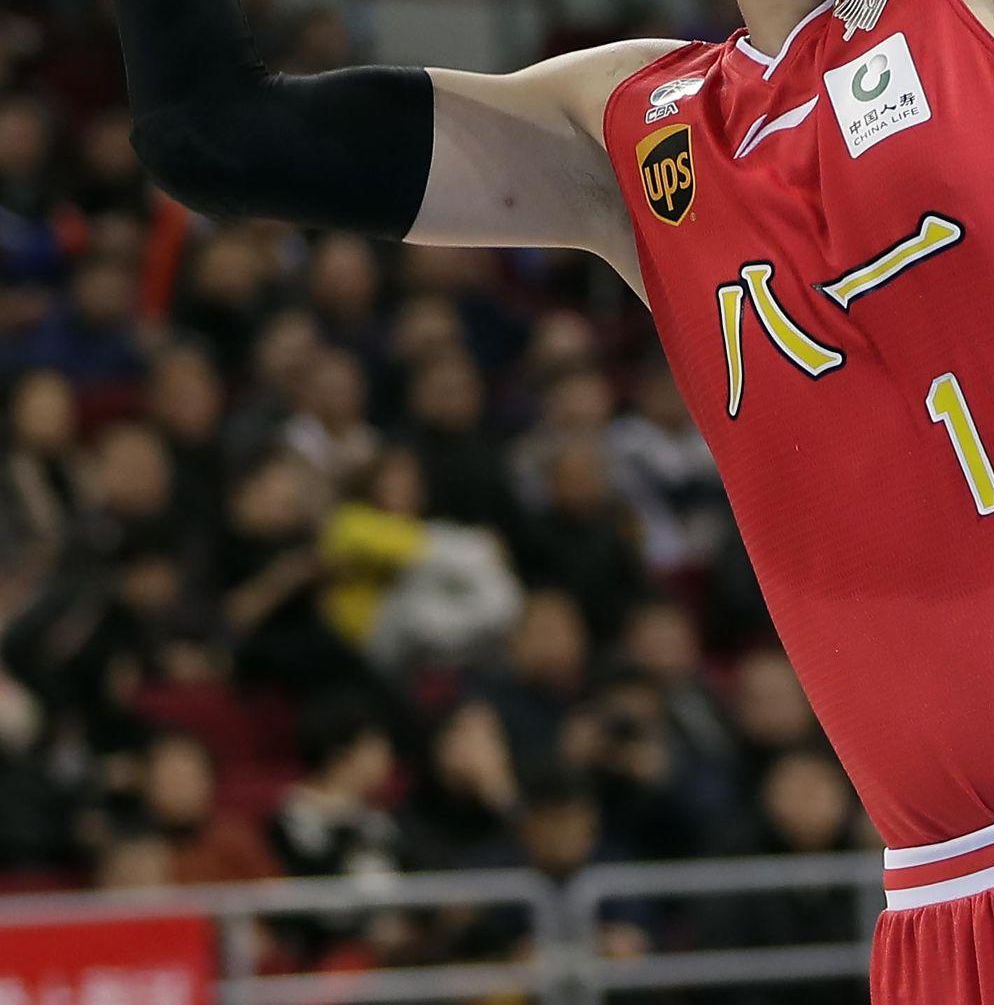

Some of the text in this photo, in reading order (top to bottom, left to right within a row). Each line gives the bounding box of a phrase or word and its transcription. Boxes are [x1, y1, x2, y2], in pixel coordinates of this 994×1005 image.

[646, 102, 678, 123] CBA
[849, 92, 915, 134] 中国人寿
[854, 107, 919, 146] CHINA LIFE
[718, 212, 964, 419] 八一
